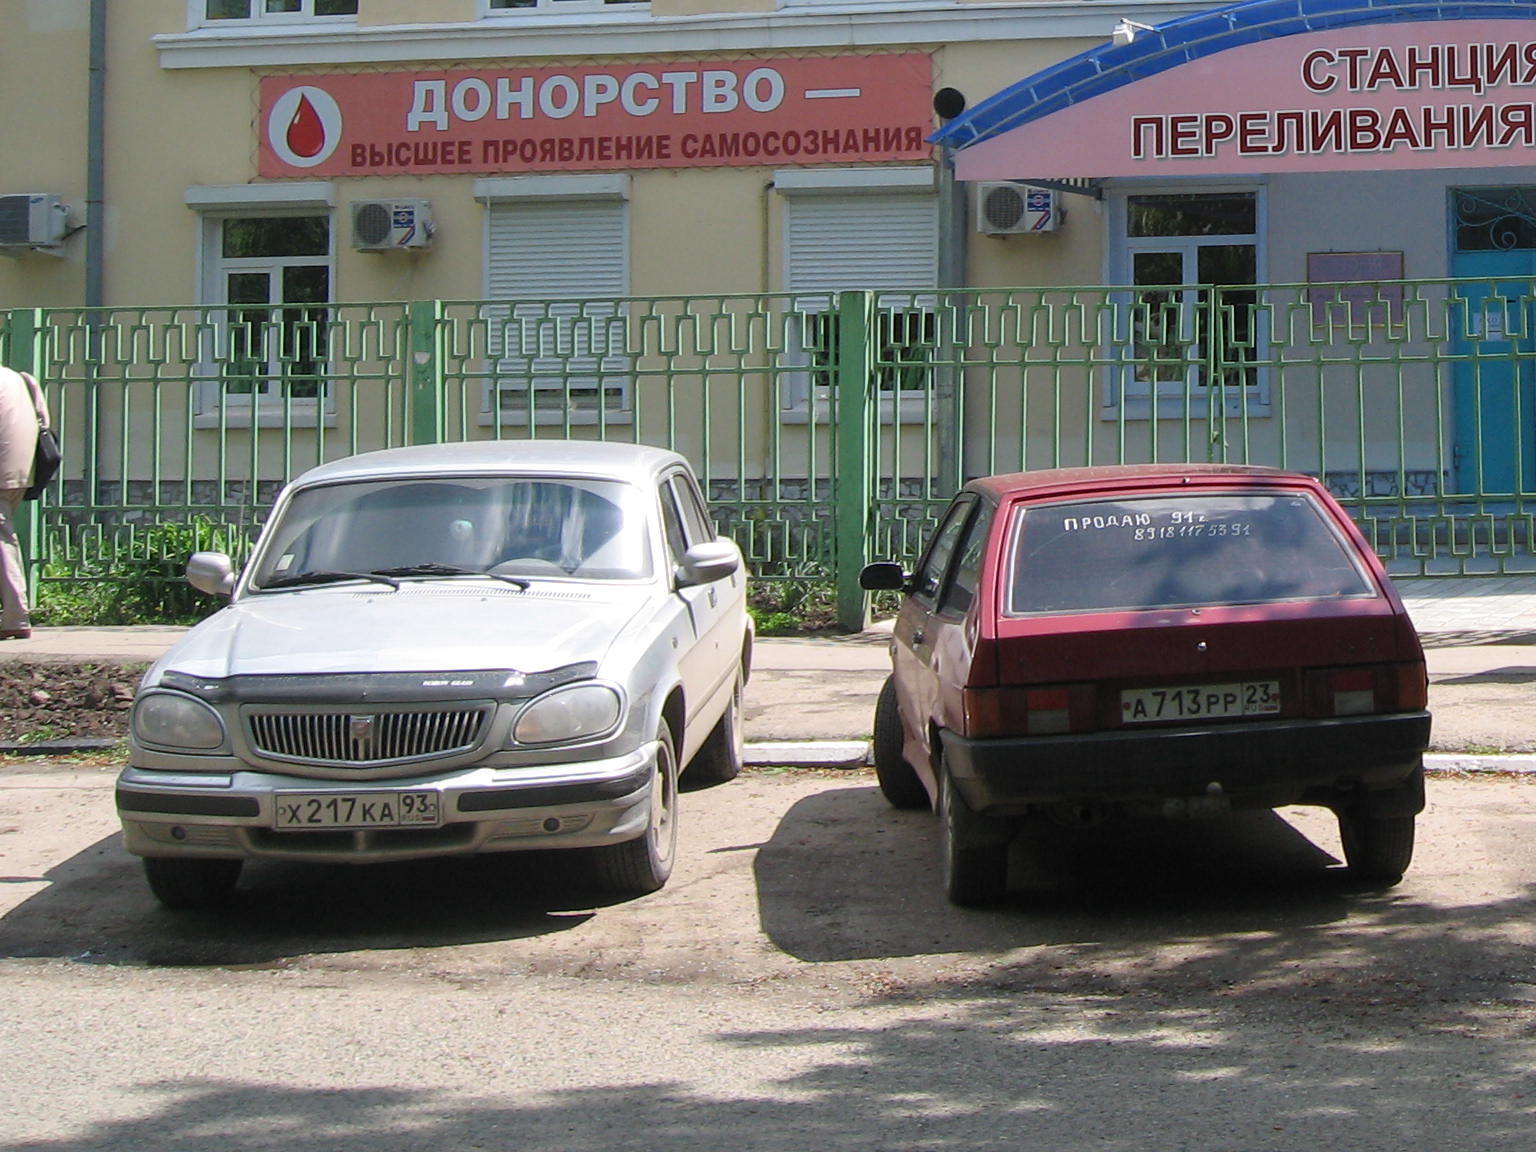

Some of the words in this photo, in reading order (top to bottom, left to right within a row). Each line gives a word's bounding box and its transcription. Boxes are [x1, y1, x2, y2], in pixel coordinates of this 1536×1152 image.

[406, 66, 786, 133] ДОНОРСТВО
[1131, 101, 1536, 159] ПЕРЕЛИВАНИЯ
[351, 139, 473, 168] ВЫСШЕЕ
[482, 134, 672, 164] ПРОЯВЛЕНИЕ
[680, 126, 924, 160] САМОСОЗНАНИЯ
[1063, 512, 1151, 532] ПРОДАЮ
[1245, 683, 1271, 704] 23
[402, 794, 429, 814] 93
